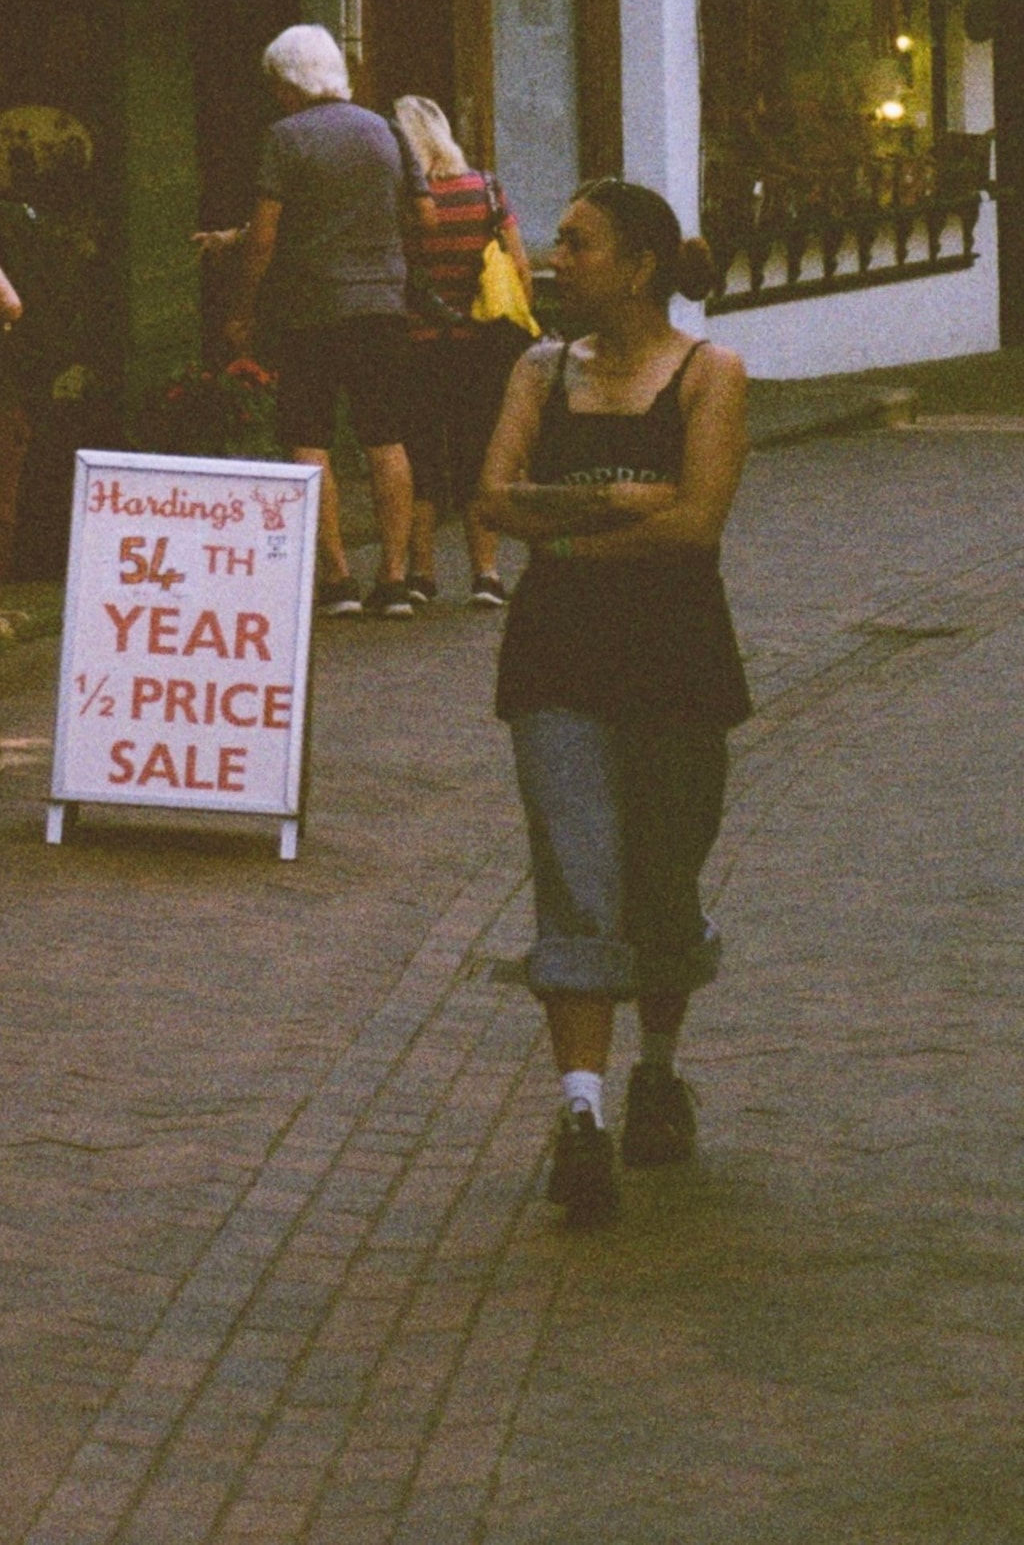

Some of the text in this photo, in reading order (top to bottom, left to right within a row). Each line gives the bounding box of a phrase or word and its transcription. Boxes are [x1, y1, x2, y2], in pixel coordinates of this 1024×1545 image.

[88, 479, 246, 532] Harding's
[118, 535, 256, 591] 54 TH
[103, 602, 272, 662] YEAR
[130, 676, 294, 730] PRICE
[107, 739, 249, 793] SALE
